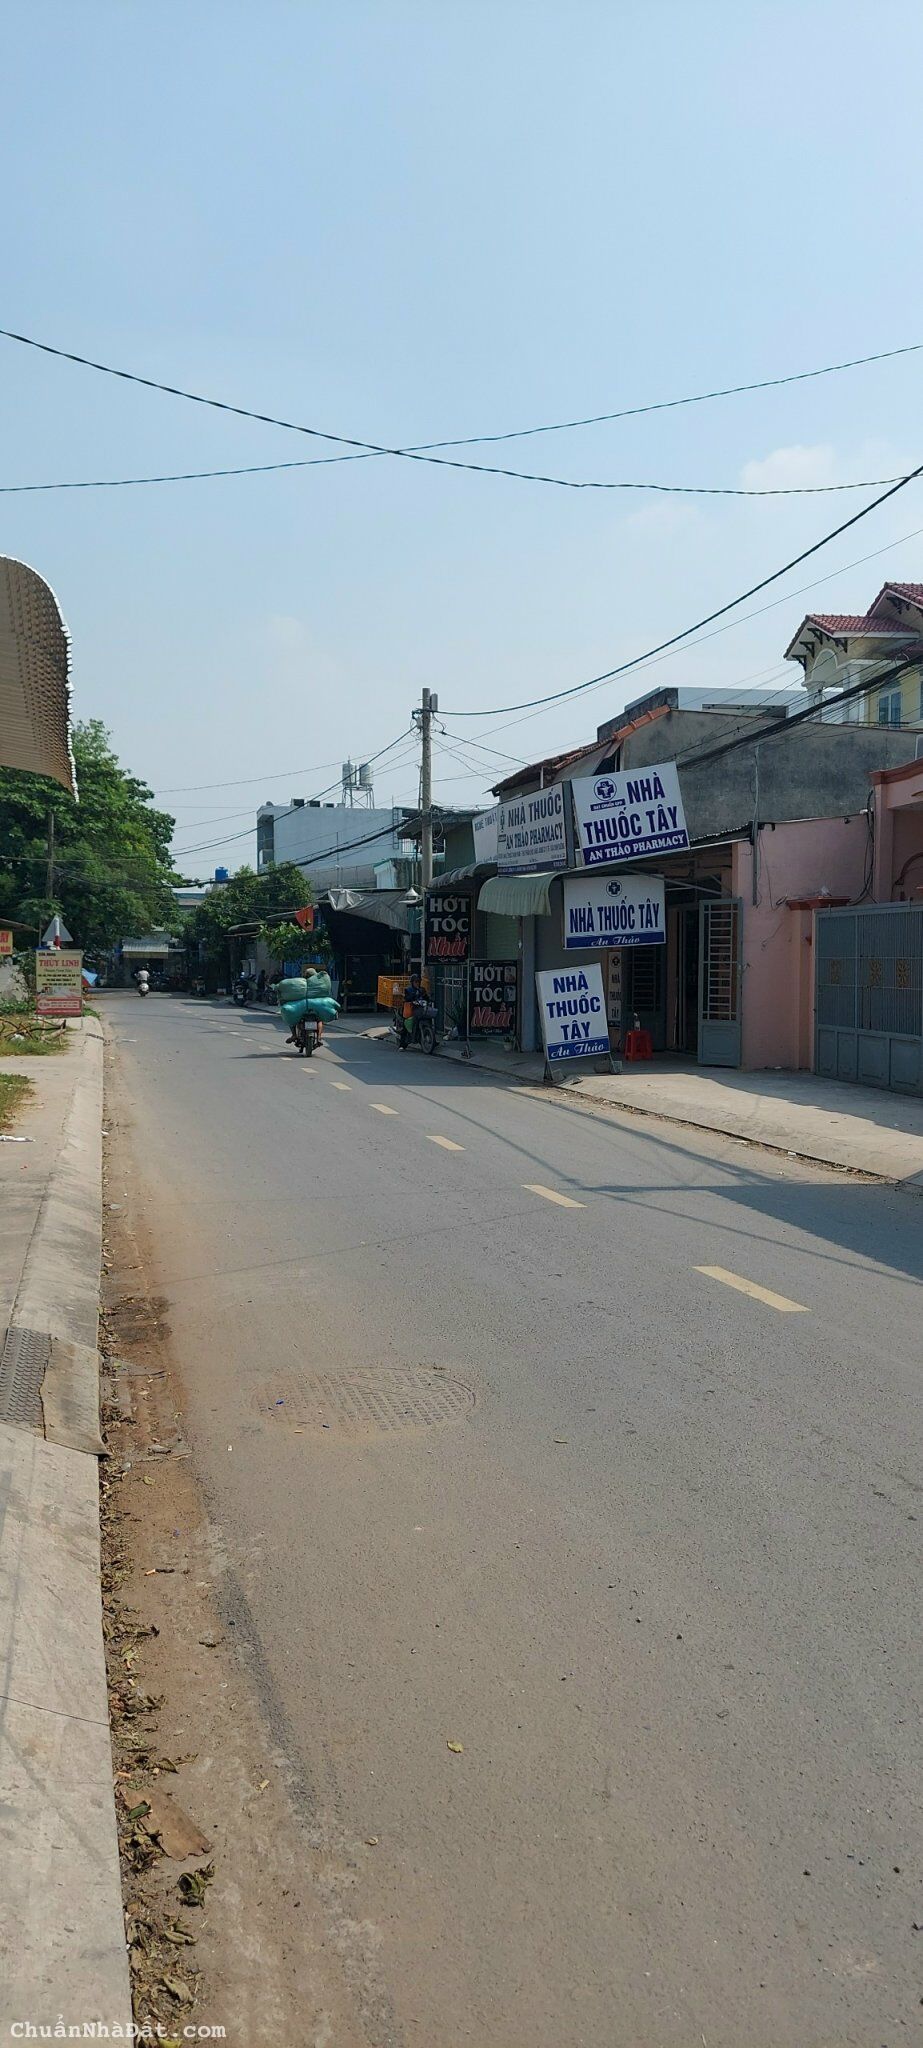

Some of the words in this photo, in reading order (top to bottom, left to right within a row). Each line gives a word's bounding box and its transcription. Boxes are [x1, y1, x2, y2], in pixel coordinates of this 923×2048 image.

[626, 772, 665, 804] NHÀ
[508, 801, 526, 828] NHÀ
[528, 788, 562, 822] THUỐC
[506, 833, 515, 850] AN
[515, 826, 529, 849] THẢO
[529, 822, 563, 846] PHARMACY
[583, 807, 642, 845] THUỐC
[645, 804, 678, 833] TÂY
[589, 849, 603, 862] AN
[605, 842, 631, 858] THẢO
[632, 834, 685, 853] PHARMACY
[429, 895, 469, 913] HỚT
[569, 902, 595, 933] NHÀ
[597, 896, 636, 931] THUỐC
[638, 898, 660, 929] TÂY
[430, 914, 469, 932] TÓC
[591, 938, 609, 946] An
[612, 935, 640, 945] Thảo
[474, 963, 504, 982] HỚT
[553, 971, 589, 994] NHÀ
[473, 984, 503, 1003] TÓC
[546, 992, 601, 1019] THUỐC
[560, 1019, 591, 1041] TÂY
[551, 1046, 570, 1058] An
[574, 1042, 605, 1055] Thảo
